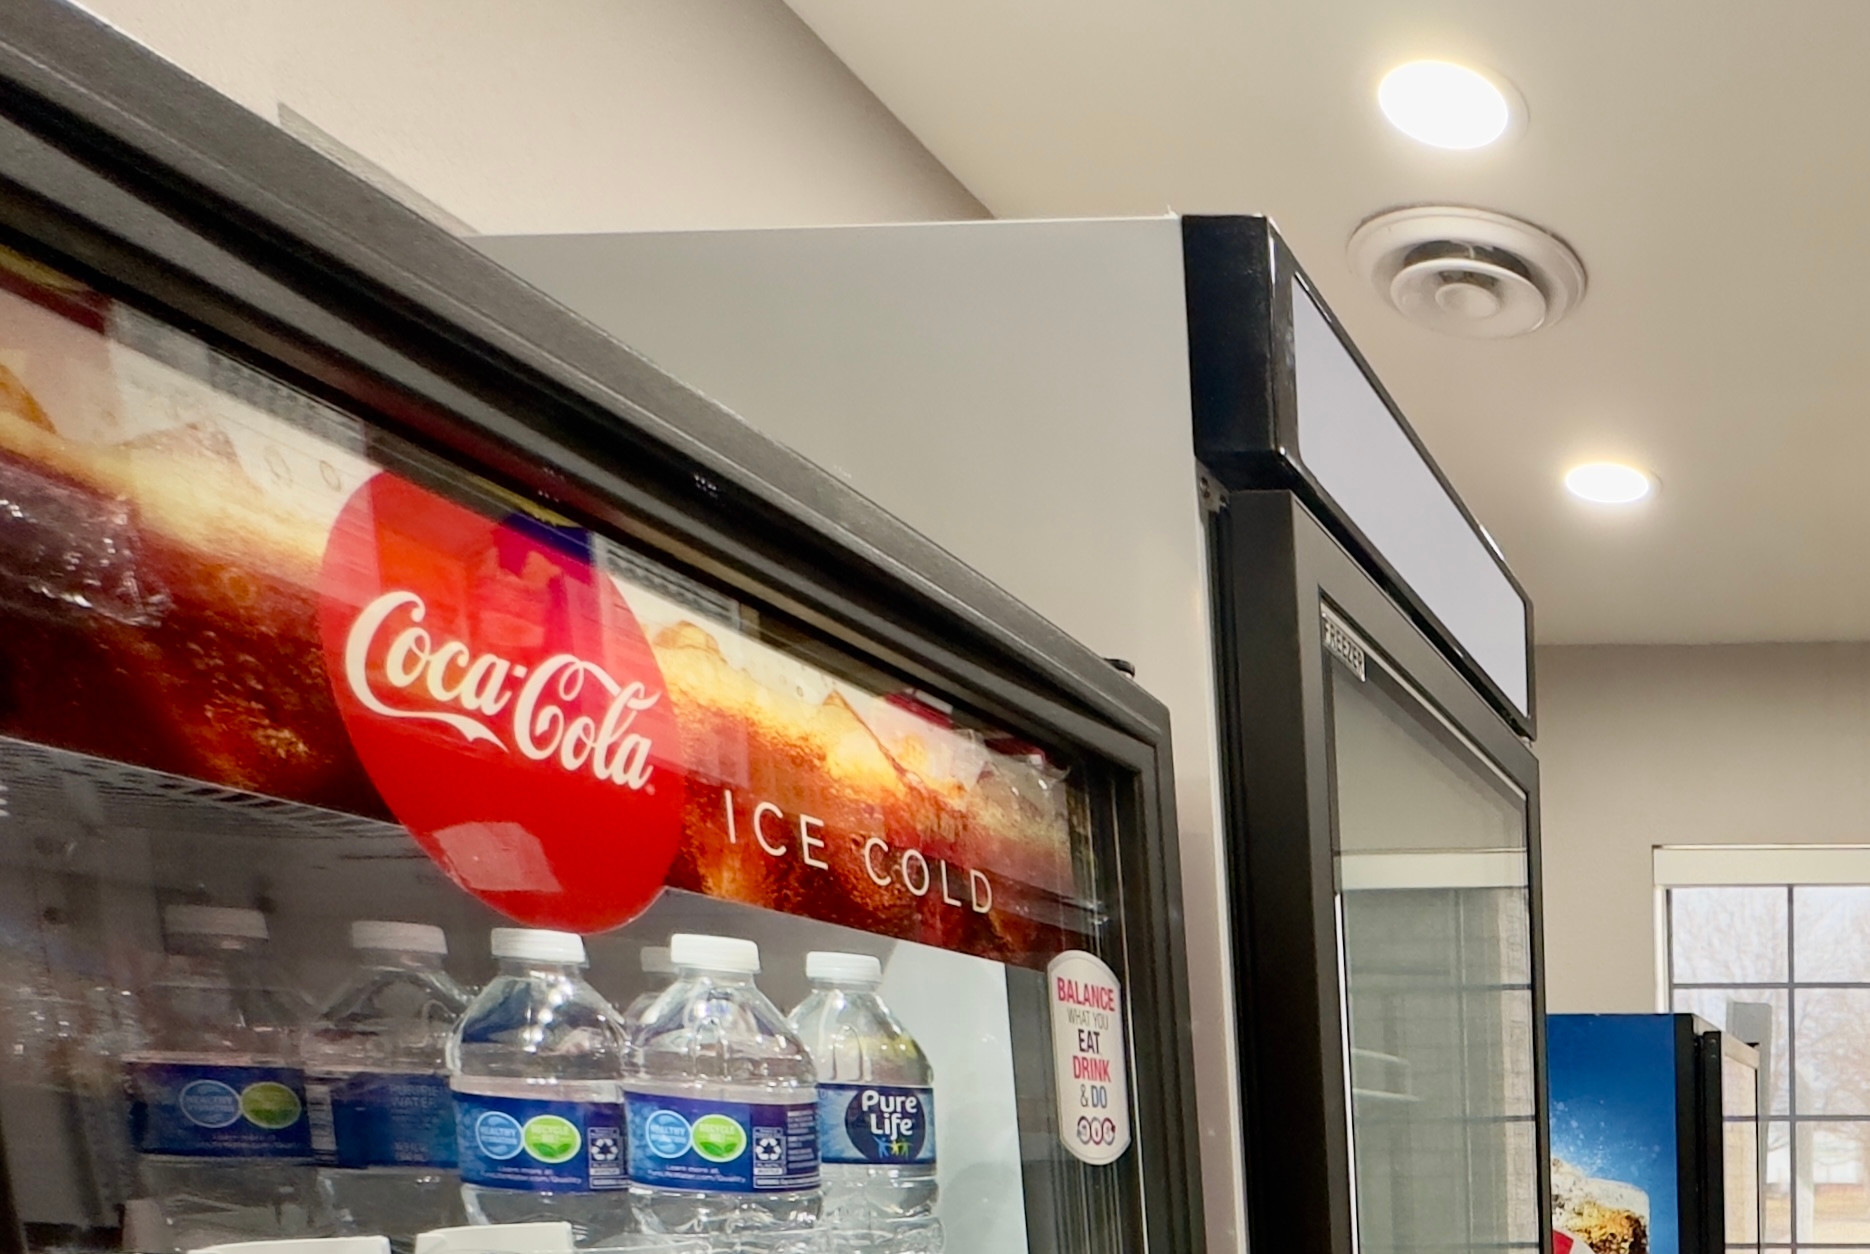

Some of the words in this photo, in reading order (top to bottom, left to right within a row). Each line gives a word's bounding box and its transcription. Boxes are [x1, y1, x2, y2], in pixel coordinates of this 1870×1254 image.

[343, 589, 662, 793] Coca-Cola
[723, 789, 829, 871] ICE
[863, 836, 994, 915] COLD
[1056, 976, 1116, 1012] BALANCE
[1066, 1007, 1091, 1025] WHAT
[1091, 1012, 1110, 1031] YOU
[1072, 1055, 1112, 1083] DRINK
[861, 1089, 918, 1115] Pure
[1079, 1084, 1089, 1108] &
[1090, 1084, 1109, 1110] DO
[869, 1114, 914, 1142] Life
